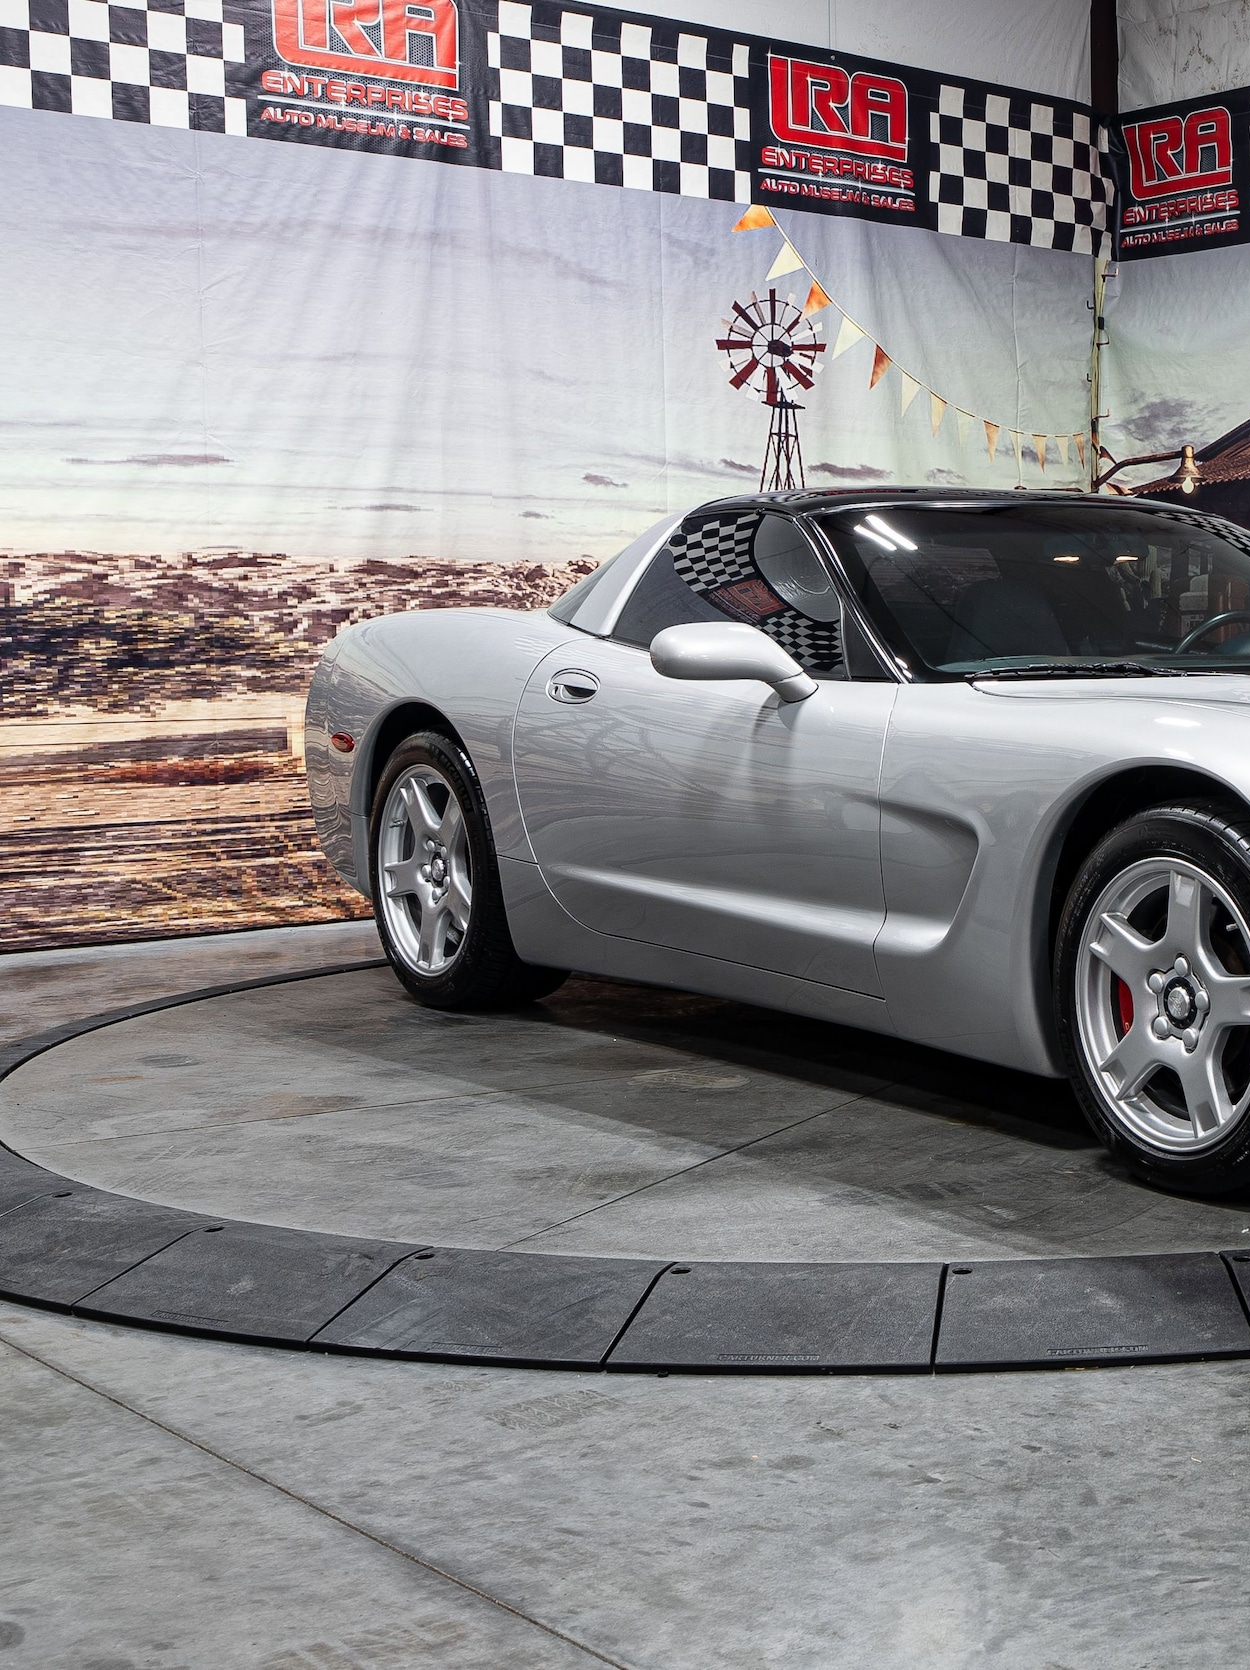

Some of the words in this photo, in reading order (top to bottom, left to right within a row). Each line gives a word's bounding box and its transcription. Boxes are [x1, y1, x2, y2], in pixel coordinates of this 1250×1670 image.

[261, 69, 469, 120] ENTERPRISES
[260, 106, 315, 127] AUTO
[316, 114, 396, 138] MUSEUM
[398, 124, 411, 141] &
[413, 128, 468, 148] SALES
[761, 146, 914, 188] ENTERPRISES
[760, 178, 799, 194] AUTO
[801, 184, 861, 204] MUSEUM
[861, 193, 870, 205] &
[871, 195, 915, 212] SALES
[1124, 189, 1239, 225] ENTERPRISES
[1122, 234, 1150, 247] AUTO
[1204, 219, 1239, 235] SALES
